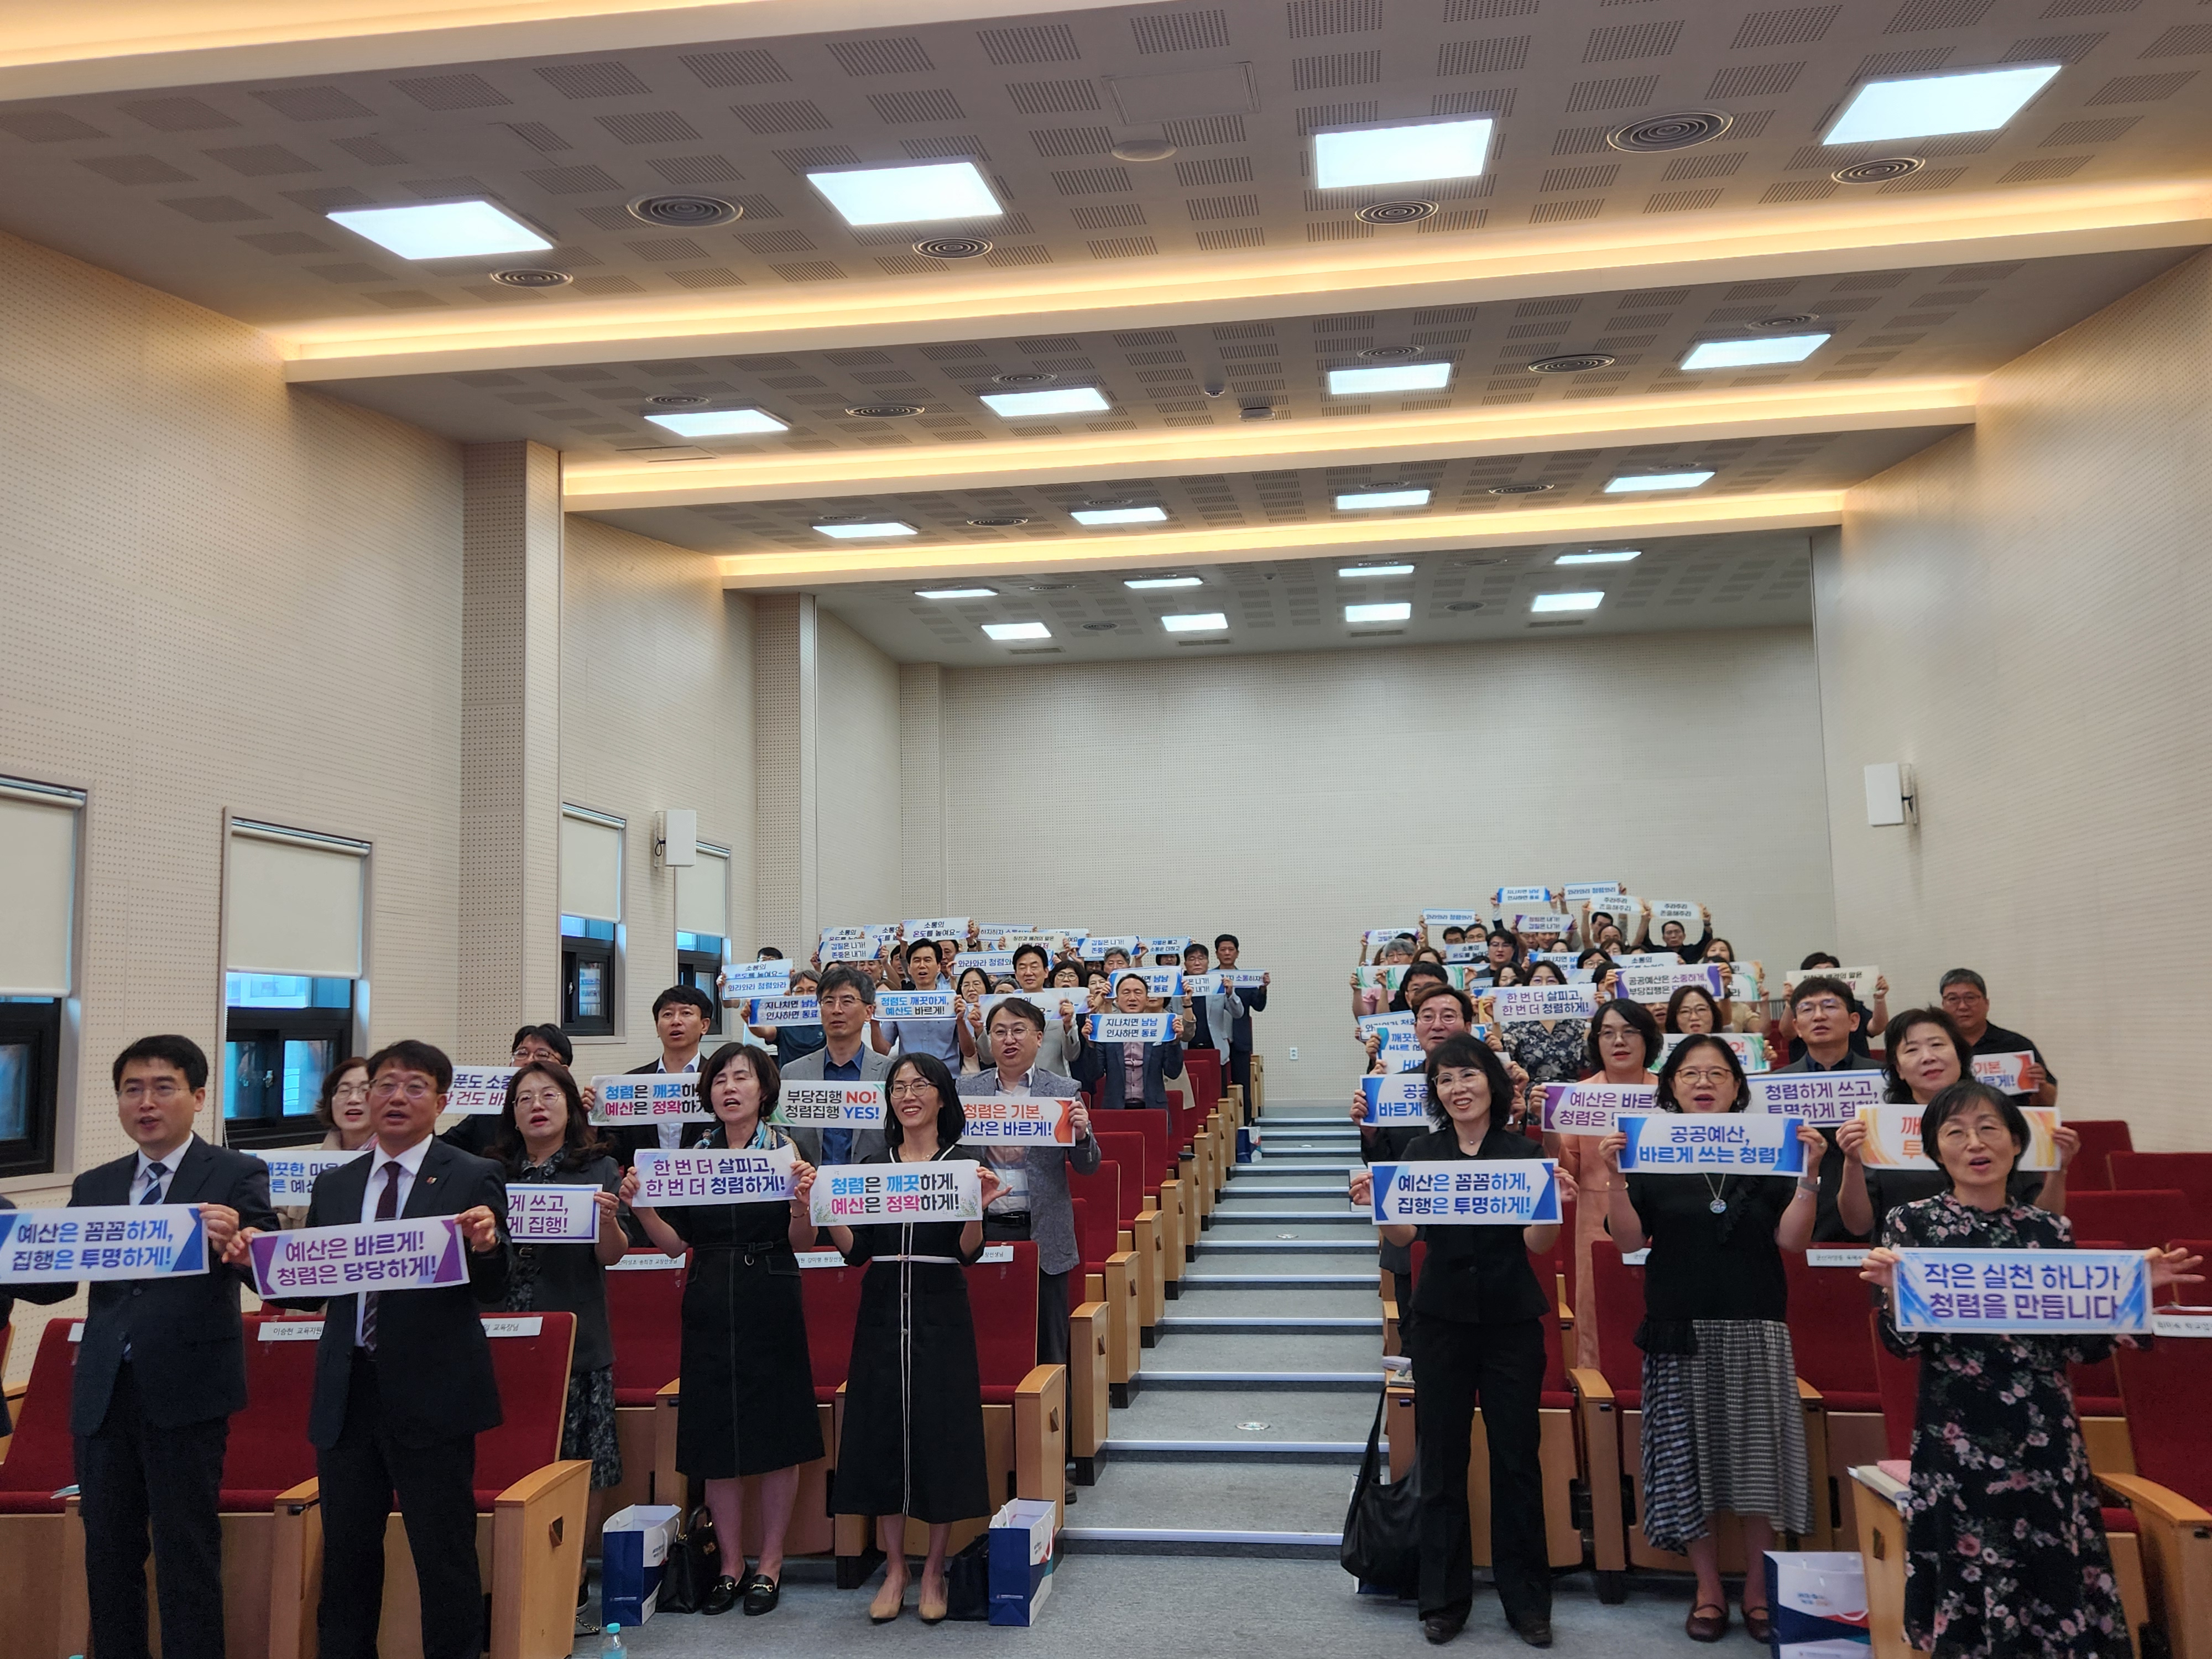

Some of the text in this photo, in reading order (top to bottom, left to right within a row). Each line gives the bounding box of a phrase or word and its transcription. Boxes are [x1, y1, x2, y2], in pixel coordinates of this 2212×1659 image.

[924, 921, 945, 929] 소통의
[958, 959, 987, 968] 와라와라
[1629, 975, 1670, 985] 공공예산은
[1507, 990, 1583, 1003] 한 번 더 살피고,
[1629, 986, 1670, 995] 부당집행은
[765, 1000, 799, 1009] 지나치면
[881, 996, 949, 1006] 청렴도 깨끗하게,
[1503, 1002, 1589, 1016] 한 번 더 청렴하게!
[766, 1010, 818, 1020] 인사하면 동료
[885, 1006, 945, 1015] 예산도 바르게!
[1106, 1018, 1158, 1027] 지나치면 남남
[1107, 1029, 1157, 1038] 인사하면 동료
[456, 1091, 486, 1105] 건도
[606, 1083, 699, 1100] 청렴은 깨끗하
[787, 1090, 877, 1104] 부당집행 NO!
[1765, 1081, 1878, 1100] 청렴하게 쓰고,
[1571, 1092, 1616, 1108] 예산은
[605, 1101, 648, 1116] 예산은
[785, 1105, 879, 1119] 청렴집행 YES!
[963, 1104, 1044, 1120] 청렴은 기본,
[1559, 1110, 1606, 1126] 청렴은
[1004, 1121, 1052, 1136] 바르게!
[1670, 1126, 1750, 1145] 공공예산,
[1639, 1146, 1693, 1164] 바르게
[1698, 1148, 1734, 1164] 쓰는
[653, 1157, 775, 1176] 한 번 더 살피고,
[646, 1176, 785, 1197] 한 번 더 청렴하게!
[831, 1173, 958, 1195] 청렴은 깨끗하게,
[1398, 1173, 1531, 1192] 예산은 꼼꼼하게,
[530, 1195, 568, 1214] 쓰고,
[831, 1194, 959, 1215] 예산은 정확하게!
[1398, 1196, 1530, 1214] 집행은 투명하게!
[18, 1219, 174, 1244] 예산은 꼼꼼하게,
[529, 1217, 567, 1234] 집행!
[285, 1230, 424, 1262] 예산은 바르게!
[12, 1246, 171, 1271] 집행은 투명하게!
[277, 1255, 437, 1286] 청렴은 당당하게!
[1924, 1263, 2120, 1291] 작은 실천 하나가
[1930, 1293, 2118, 1321] 청렴을 만듭니다
